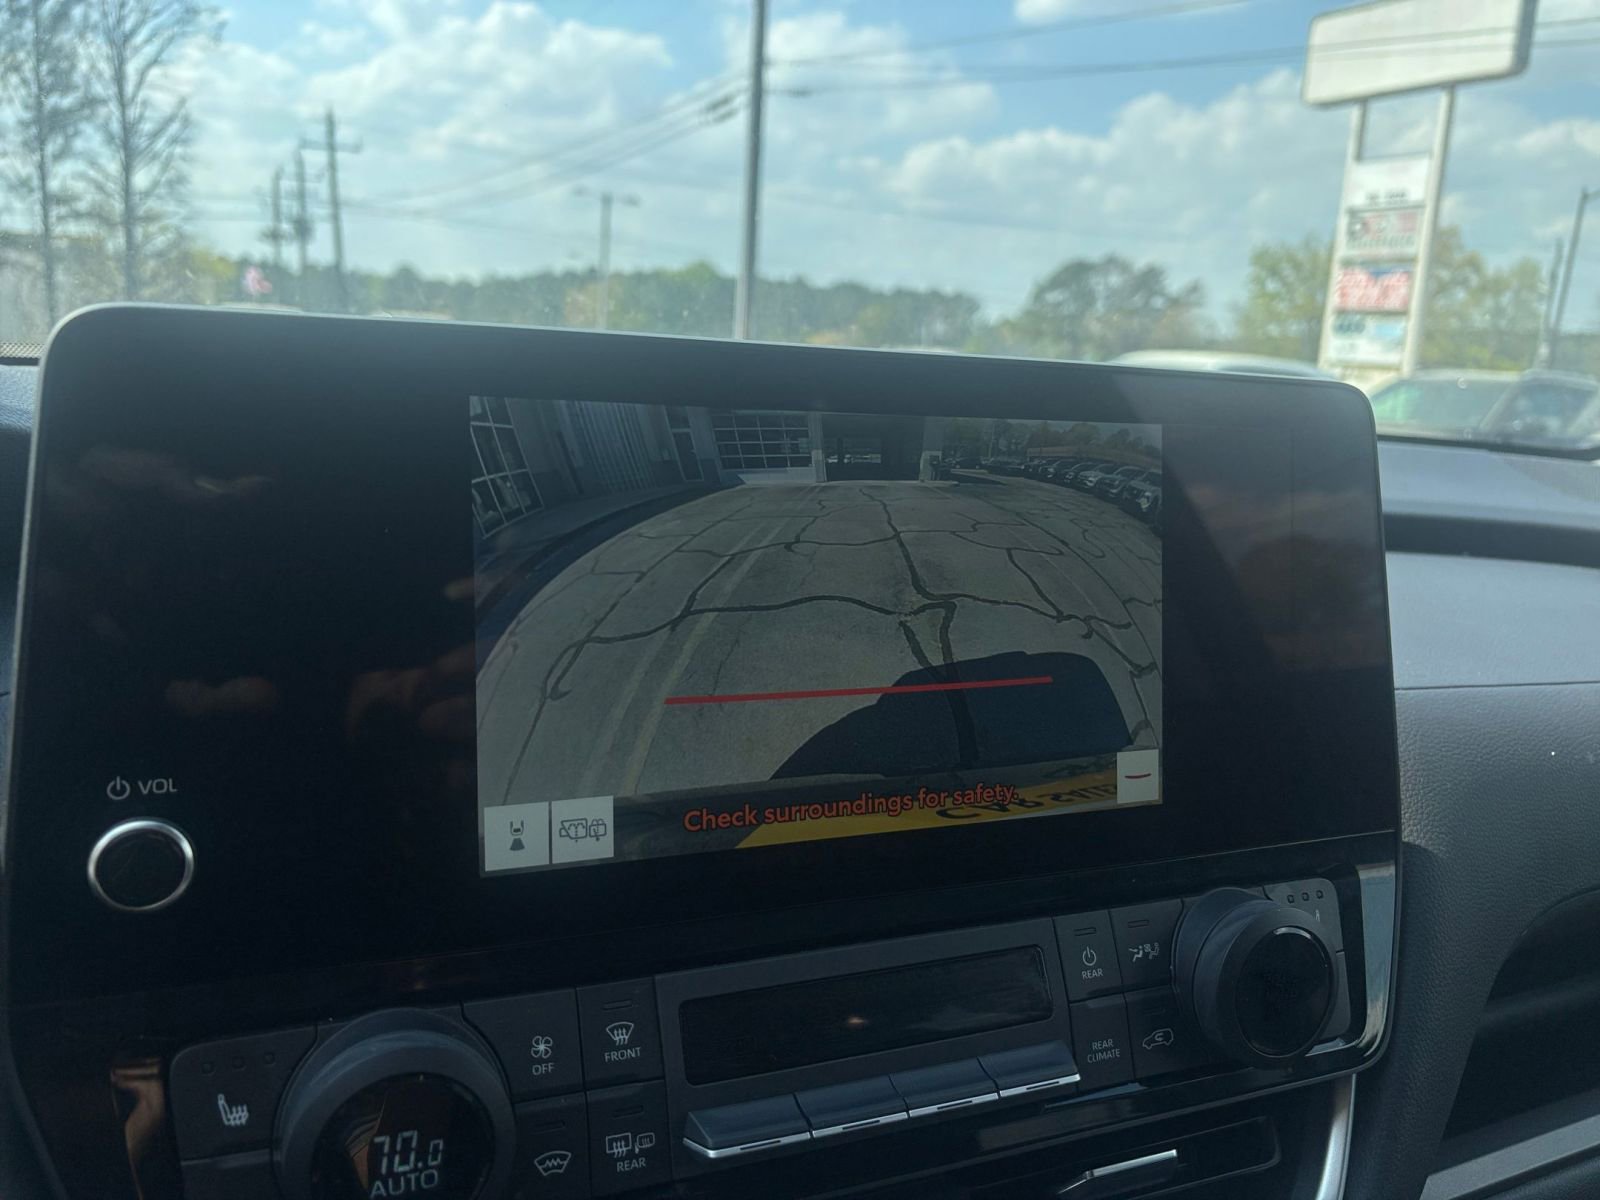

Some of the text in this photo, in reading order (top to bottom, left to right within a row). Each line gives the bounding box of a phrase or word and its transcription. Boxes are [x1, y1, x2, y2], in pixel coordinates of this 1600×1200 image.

[137, 778, 178, 795] VOL
[683, 783, 1020, 832] Check surroundings for safety.
[1081, 968, 1104, 980] REAR
[1092, 1038, 1114, 1050] REAR
[604, 1046, 642, 1062] FRONT
[1087, 1049, 1121, 1063] CLIMATE
[532, 1062, 555, 1076] OFF
[616, 1156, 647, 1173] REAR
[369, 1168, 439, 1199] AUTO
